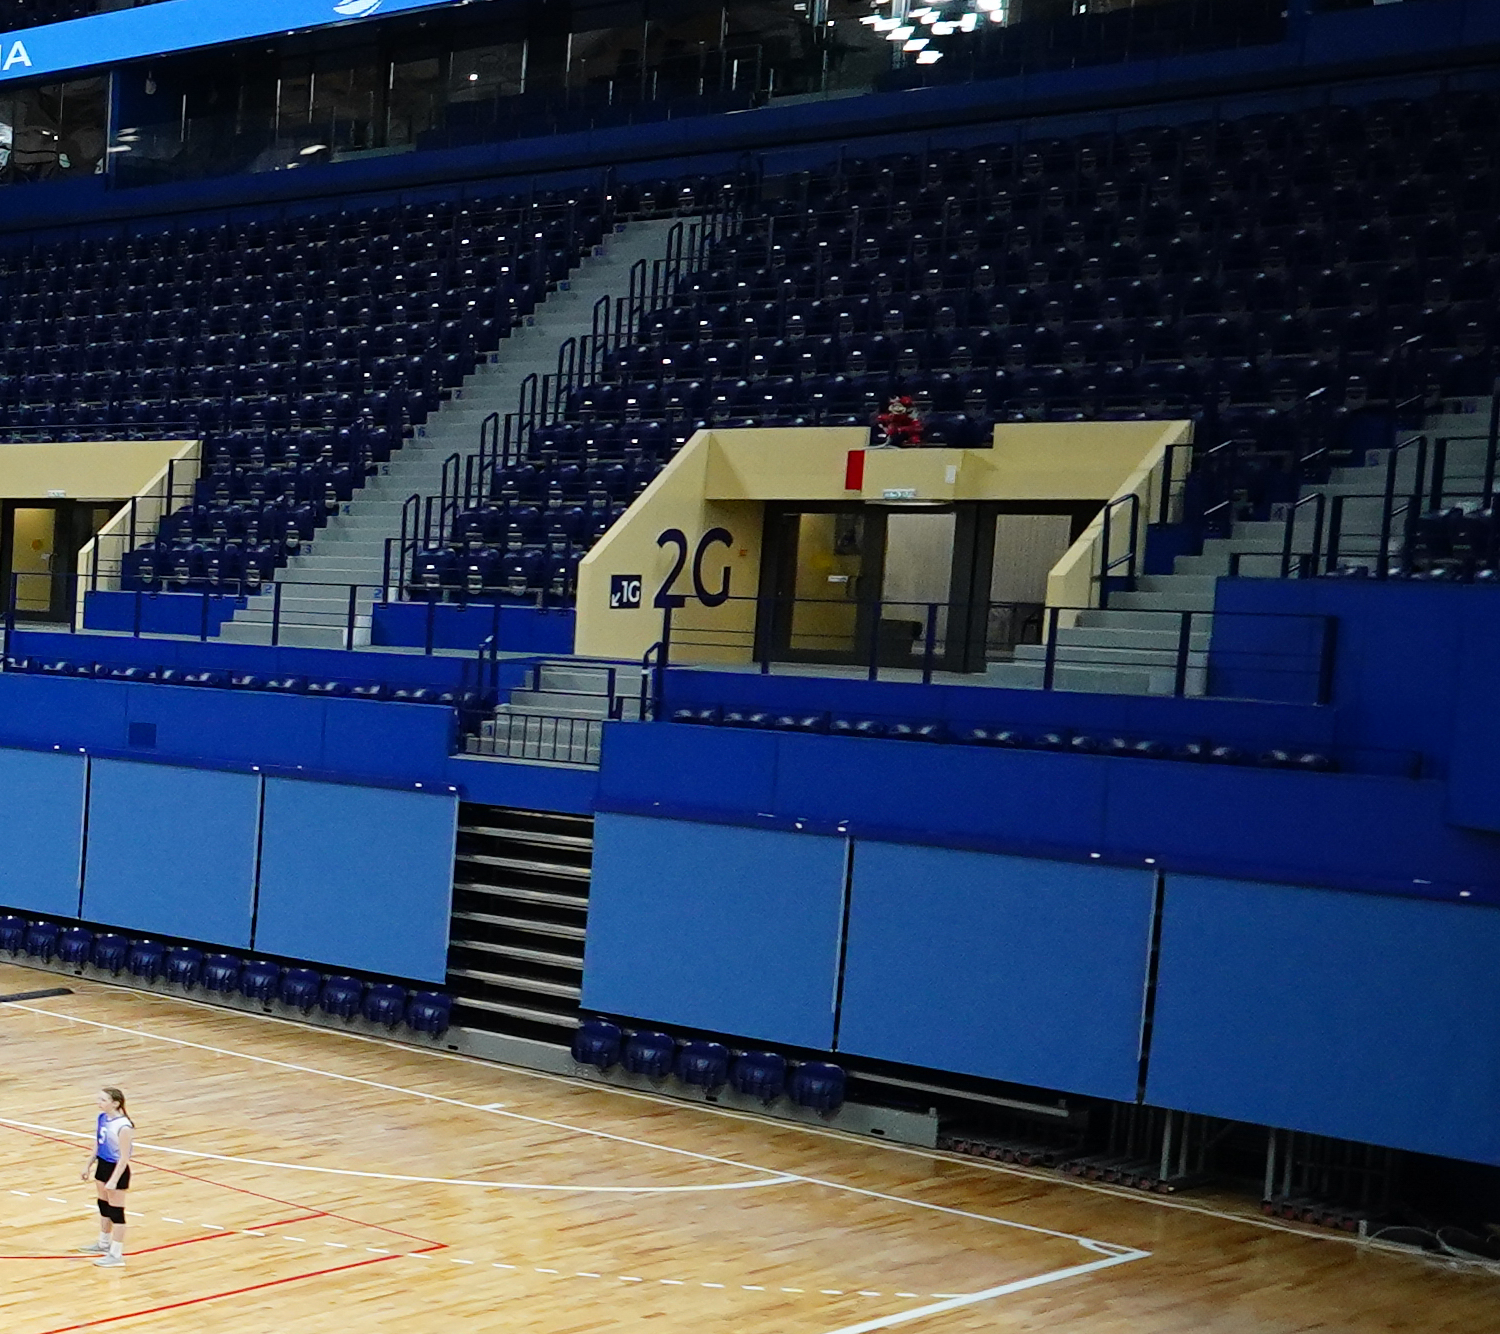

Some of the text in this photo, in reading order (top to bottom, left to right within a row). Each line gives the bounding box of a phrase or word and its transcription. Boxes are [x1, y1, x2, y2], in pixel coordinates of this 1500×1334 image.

[653, 527, 734, 609] 2G
[620, 580, 641, 604] 1G
[98, 1126, 108, 1145] 5
